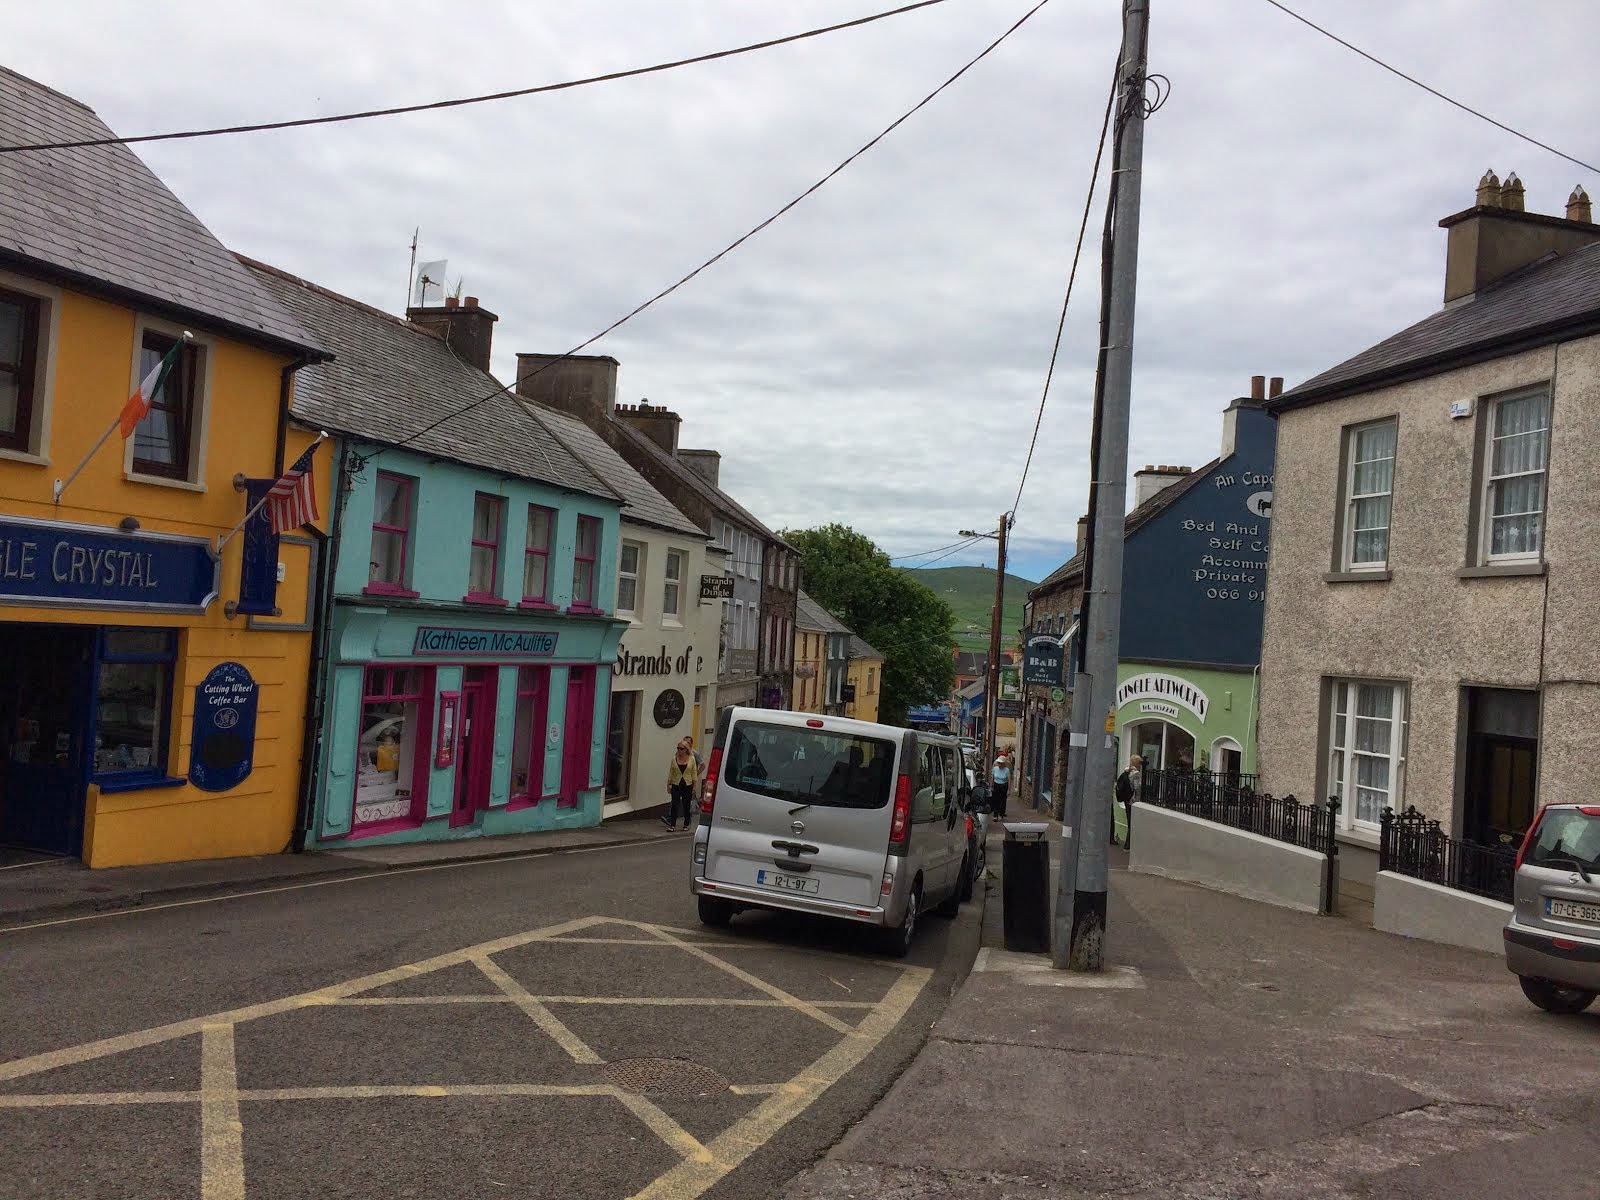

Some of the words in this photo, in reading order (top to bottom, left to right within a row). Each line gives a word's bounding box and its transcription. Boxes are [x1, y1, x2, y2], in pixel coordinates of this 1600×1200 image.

[1215, 474, 1235, 489] An
[1181, 519, 1215, 532] Bed
[1226, 522, 1258, 535] And
[1209, 537, 1242, 550] Self
[52, 540, 158, 588] CRYSTAL
[703, 576, 733, 585] Strands
[1192, 568, 1255, 583] Private
[703, 588, 730, 597] Dingle
[1207, 588, 1240, 600] 066
[420, 630, 487, 650] Kathleen
[490, 633, 553, 652] McAuliffe
[613, 642, 672, 676] Strands
[676, 645, 693, 675] of
[1029, 657, 1057, 667] B&B
[204, 684, 230, 695] Cutting
[231, 683, 254, 693] Wheel
[1118, 677, 1151, 703] DINGLE
[1153, 677, 1205, 715] ARTWORKS
[208, 696, 231, 707] Coffee
[233, 695, 247, 704] Bar
[774, 875, 807, 890] 12-L-97
